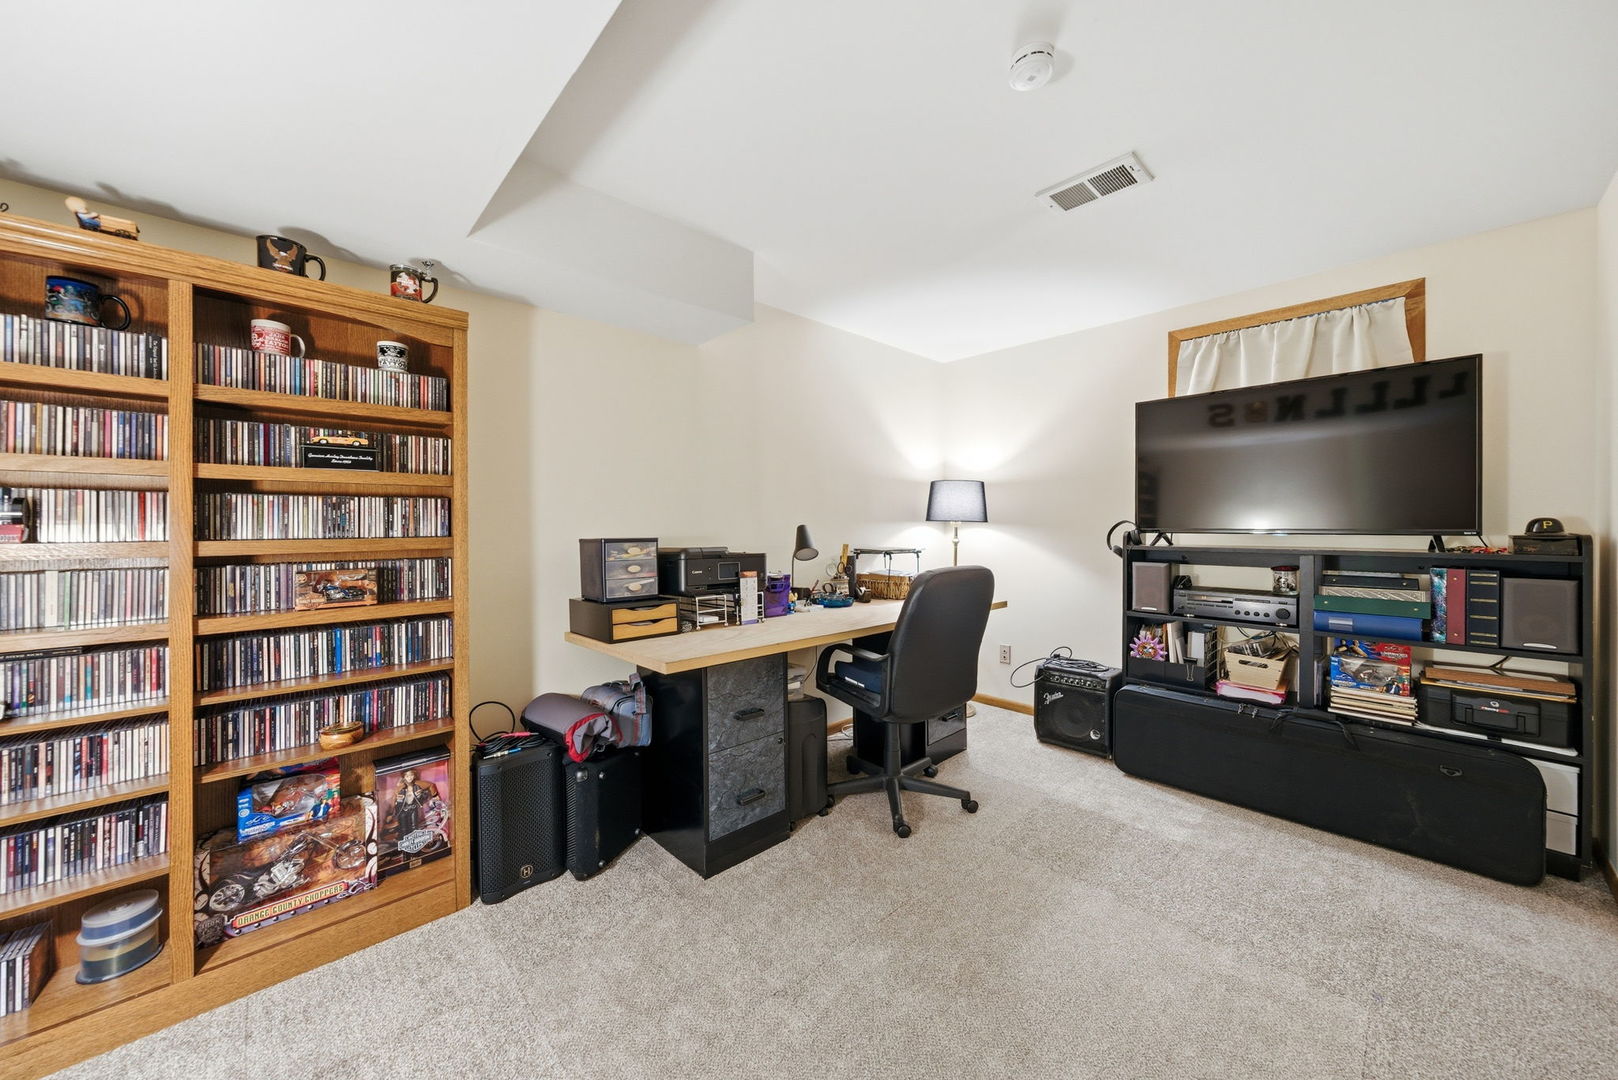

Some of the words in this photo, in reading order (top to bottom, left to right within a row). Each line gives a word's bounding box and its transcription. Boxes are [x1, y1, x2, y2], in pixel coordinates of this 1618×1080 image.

[1543, 520, 1553, 529] P
[1043, 691, 1064, 705] Fender
[237, 907, 270, 926] ORANGE
[272, 897, 304, 915] COUNTY
[304, 883, 343, 904] CHOPPERS
